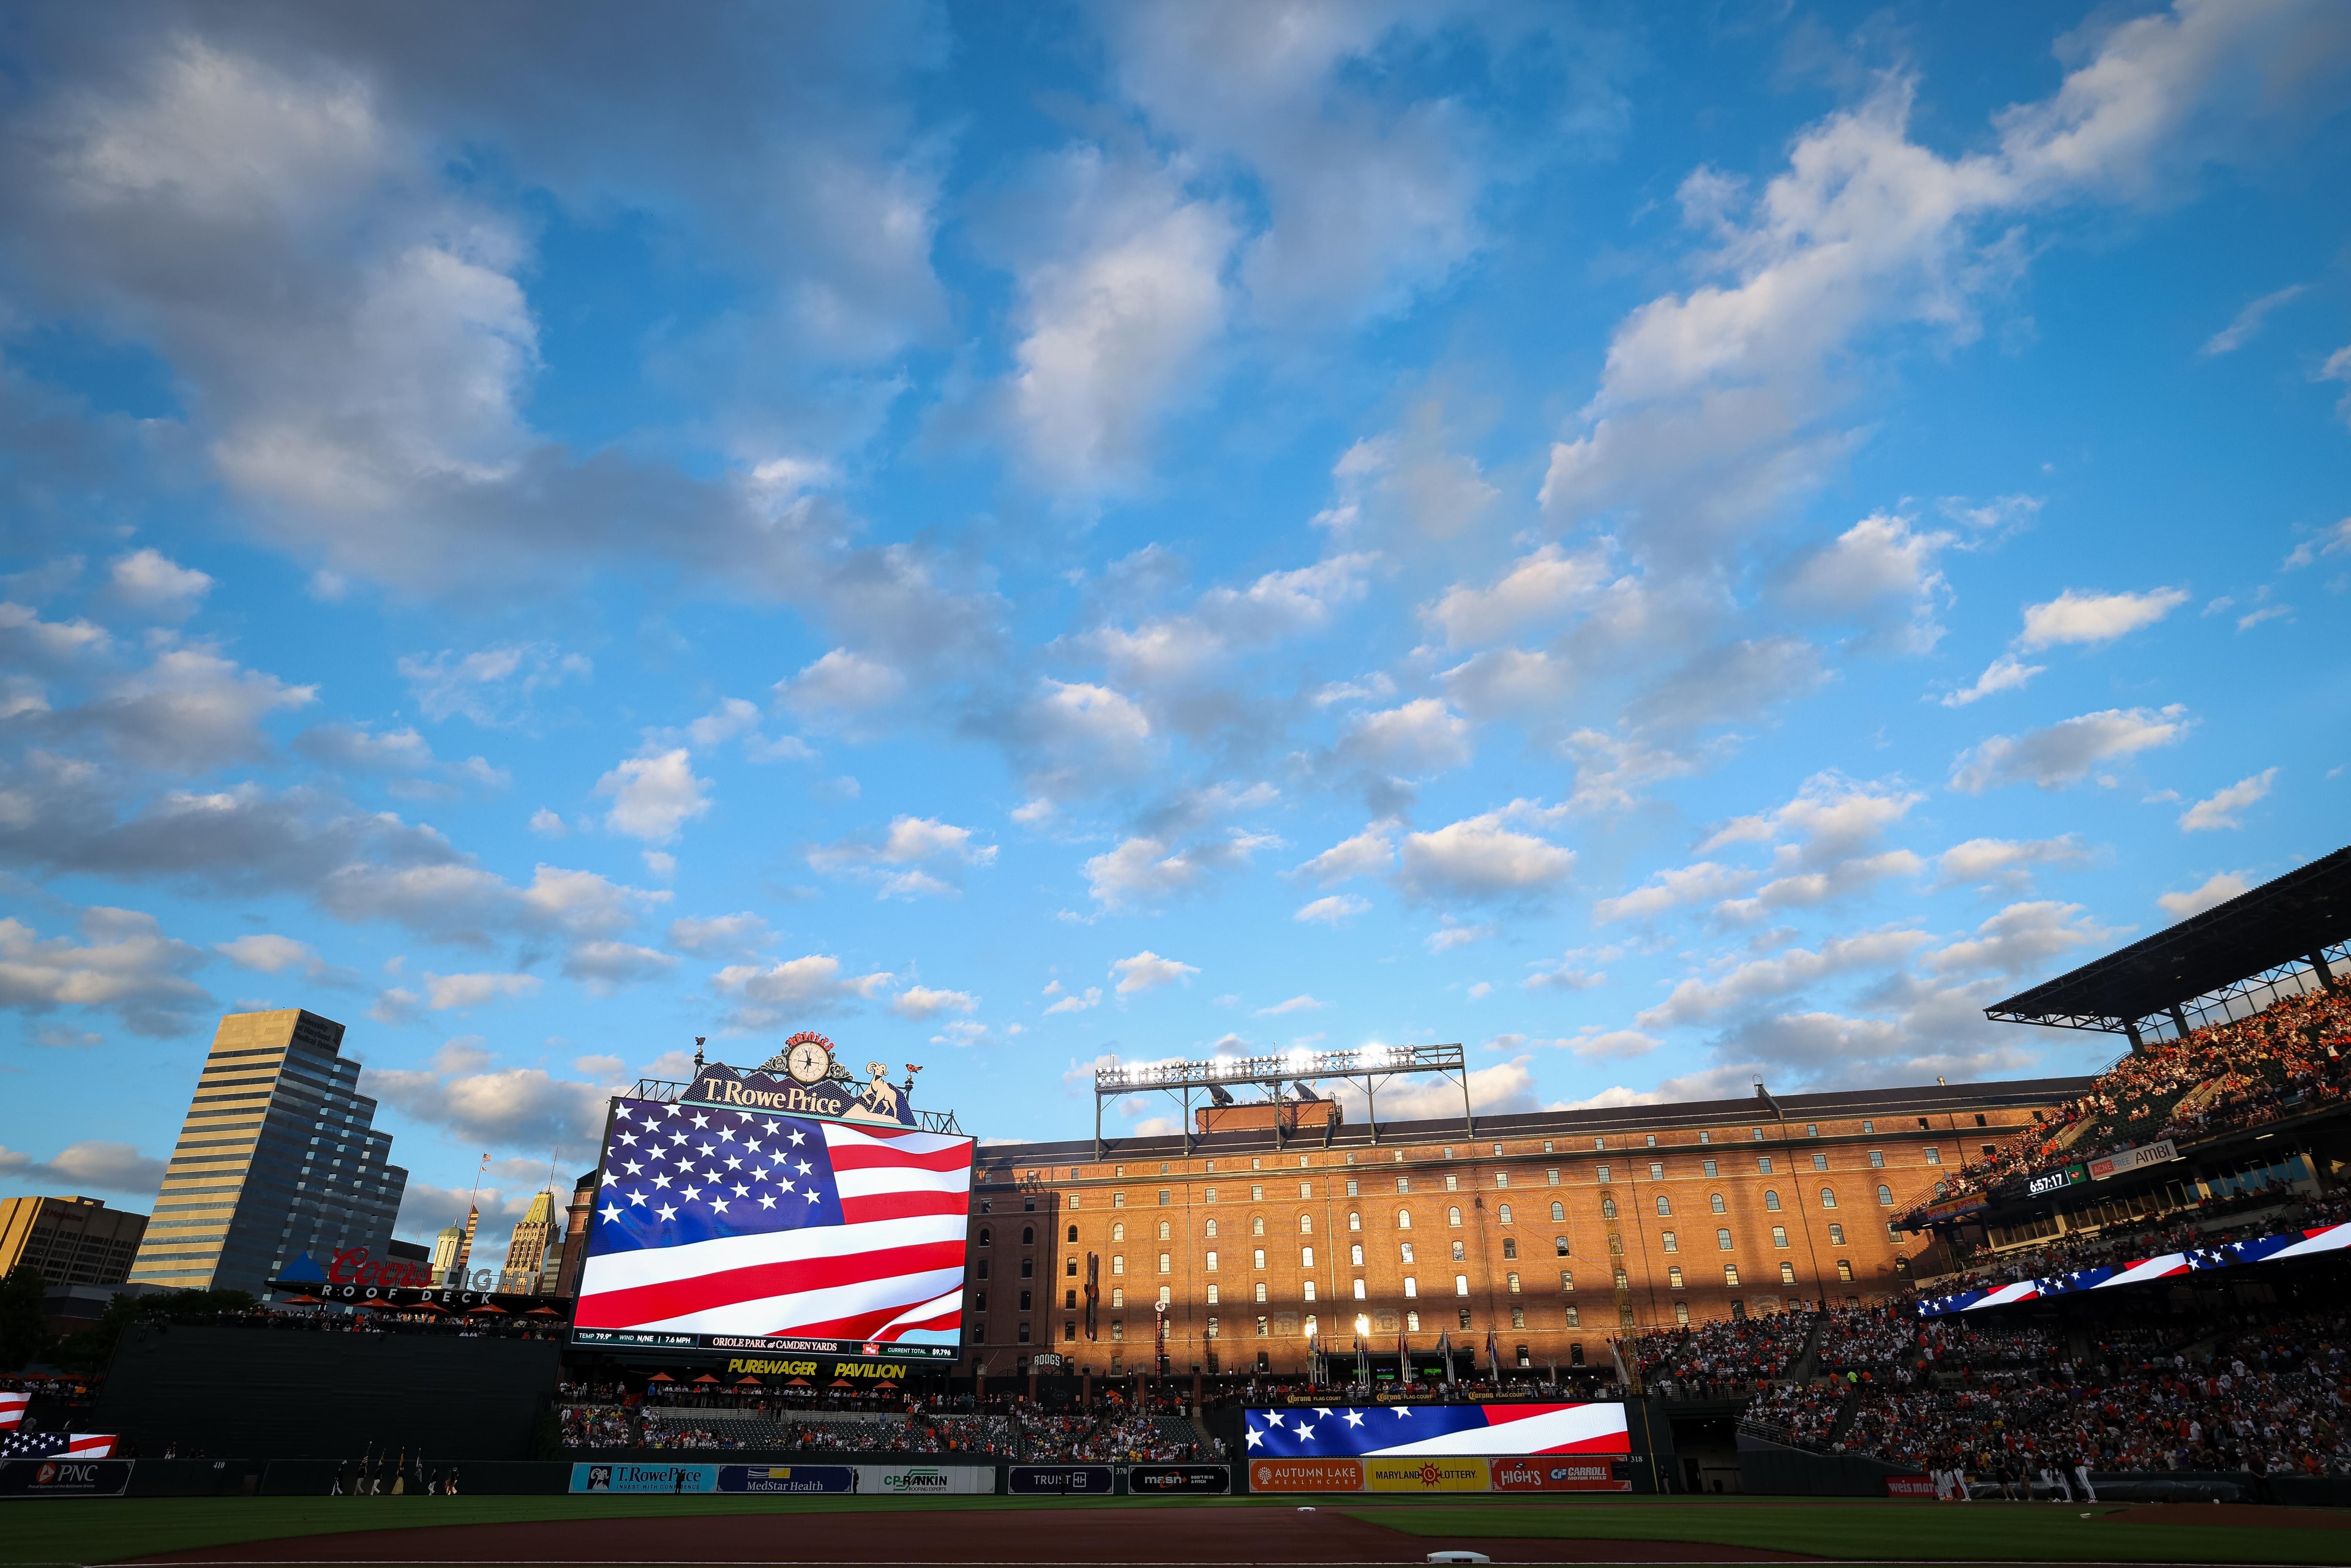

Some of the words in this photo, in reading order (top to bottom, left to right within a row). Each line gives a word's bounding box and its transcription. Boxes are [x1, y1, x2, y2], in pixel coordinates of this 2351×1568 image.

[2094, 1162, 2112, 1174] ACNE
[2113, 1156, 2131, 1168] FREE
[2030, 1173, 2063, 1193] 6:57:17
[328, 1247, 434, 1288] Coors
[441, 1266, 538, 1296] LIGHT
[321, 1285, 397, 1299] ROOF
[421, 1290, 492, 1304] DECK
[713, 1337, 744, 1347] ORIOLE
[744, 1339, 767, 1348] PARK
[776, 1340, 811, 1350] CAMDEN
[811, 1343, 837, 1351] YARDS
[728, 1359, 817, 1376] PUREWAGER
[834, 1363, 906, 1379] PAVILION
[1287, 1394, 1311, 1403] Corona
[1376, 1392, 1401, 1402] Corona
[1468, 1391, 1494, 1401] Corona
[58, 1465, 98, 1481] PNC
[1275, 1468, 1323, 1477] AUTUMN
[1328, 1468, 1355, 1477] LAKE
[1376, 1471, 1420, 1479] MARYLAND
[1439, 1470, 1476, 1479] LOTTERY
[1501, 1470, 1542, 1485] HIGH'S
[1568, 1467, 1607, 1476] CARROLL
[746, 1480, 788, 1491] MedStar
[790, 1480, 823, 1491] Health
[1888, 1479, 1911, 1493] weis
